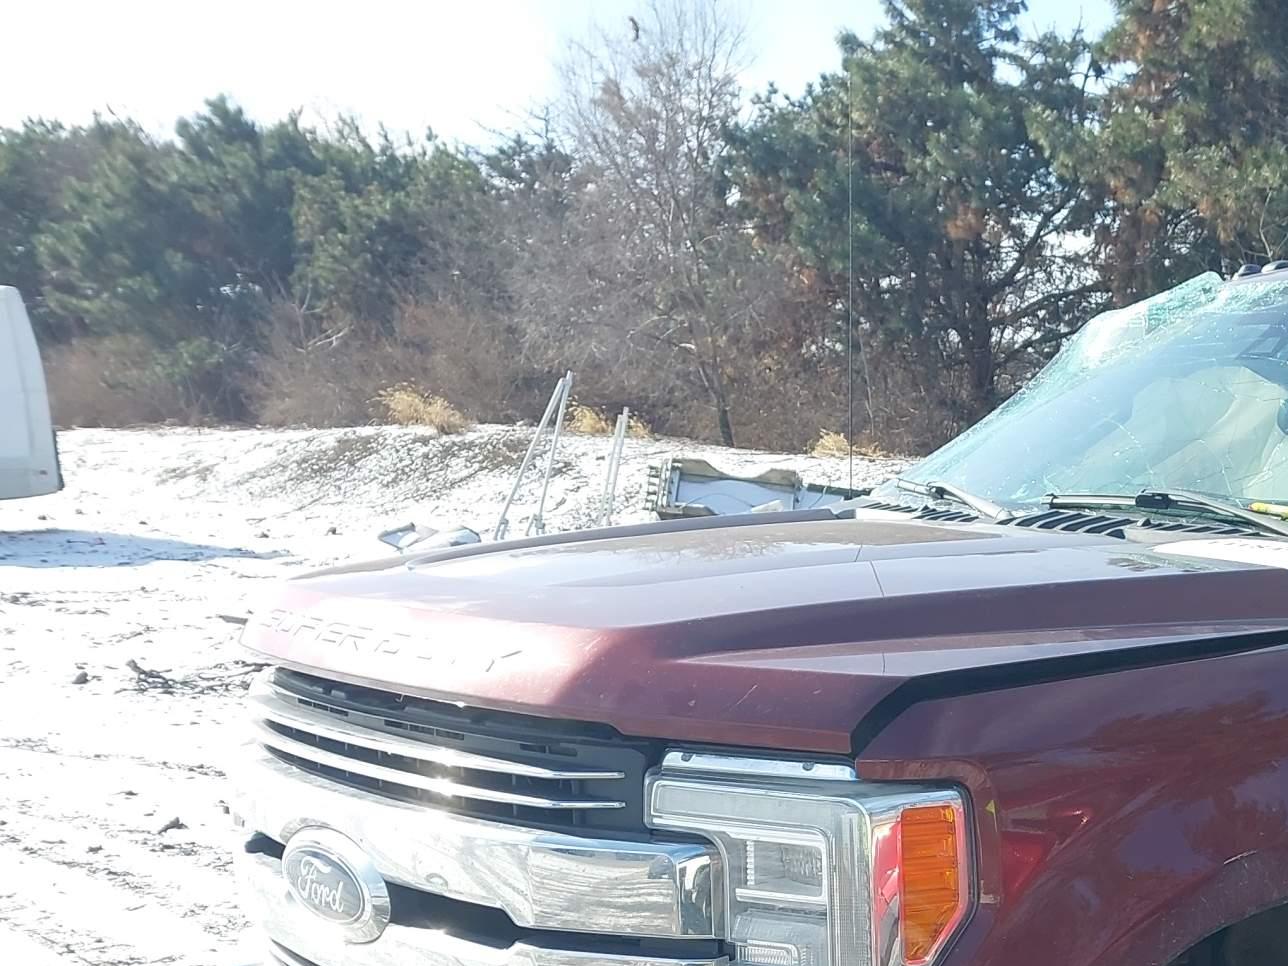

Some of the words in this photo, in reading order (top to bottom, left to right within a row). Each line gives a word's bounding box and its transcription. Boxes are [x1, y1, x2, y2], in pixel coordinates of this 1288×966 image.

[258, 608, 373, 651] SUPER
[374, 632, 523, 672] DY
[298, 856, 344, 912] Ford
